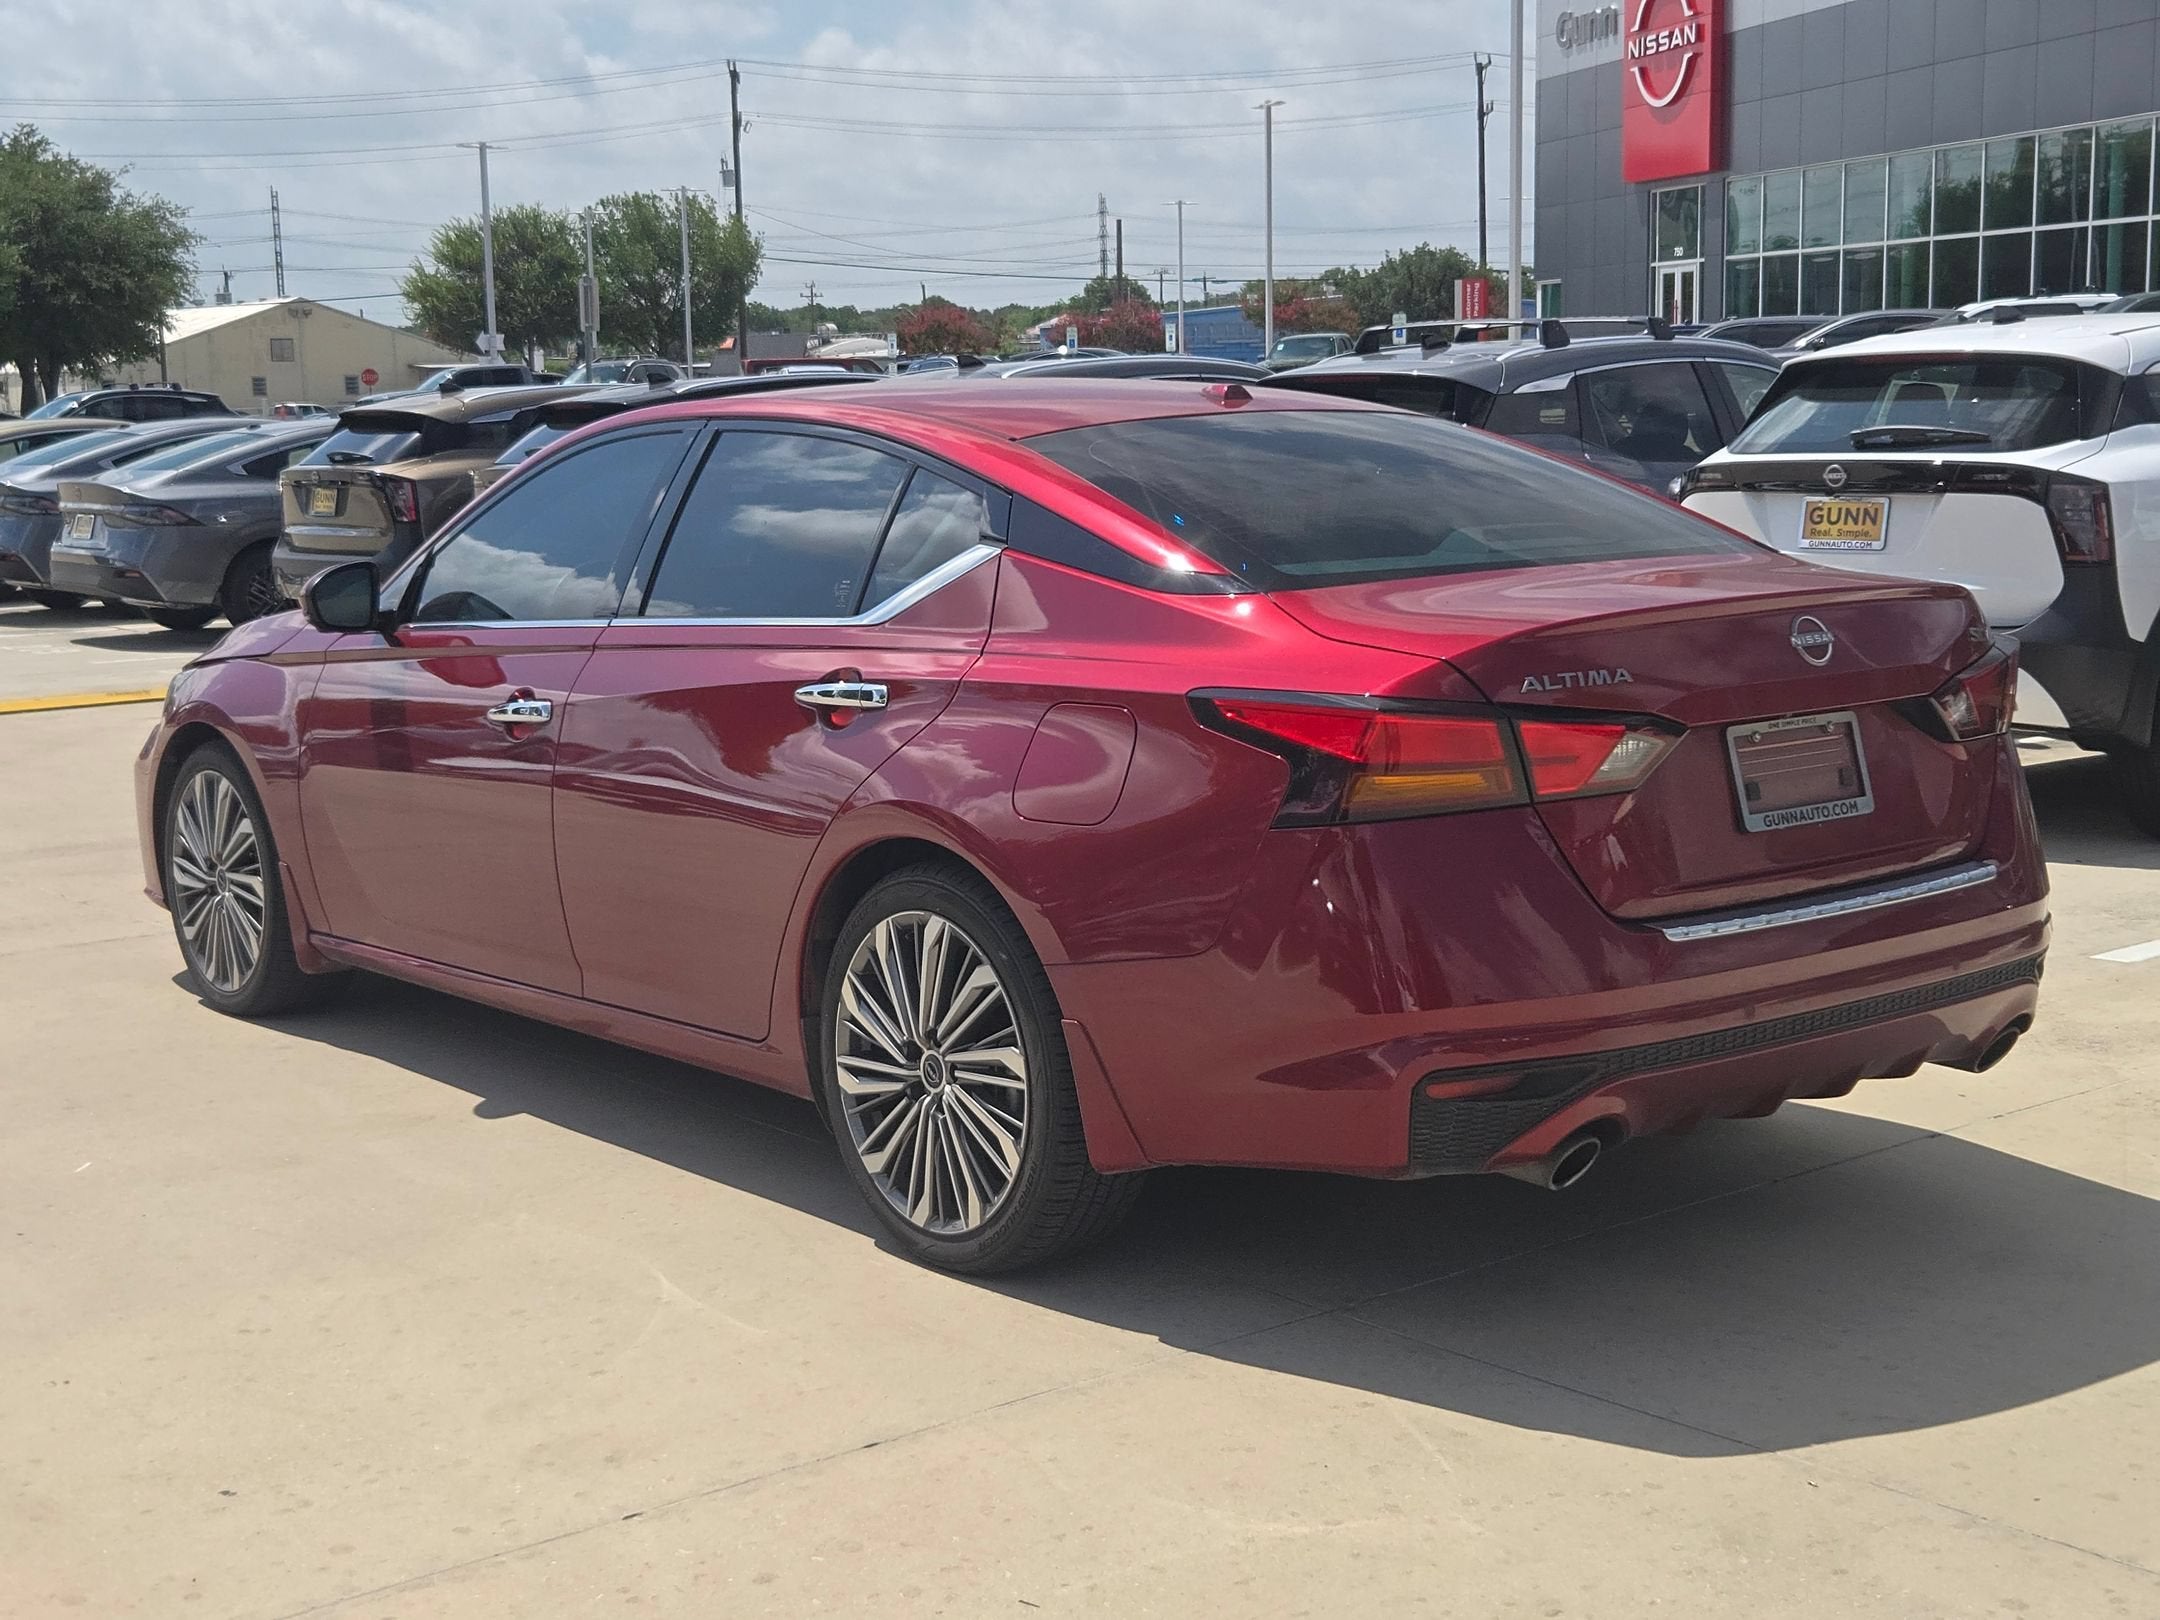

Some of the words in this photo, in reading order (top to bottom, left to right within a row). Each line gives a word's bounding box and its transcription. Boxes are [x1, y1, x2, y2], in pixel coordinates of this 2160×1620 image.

[1556, 6, 1618, 50] Gunn
[1628, 22, 1696, 60] NISSAN
[1673, 246, 1684, 257] 750
[1809, 506, 1879, 526] GUNN
[1808, 540, 1873, 549] GUNNAUTO.COM
[1810, 528, 1833, 537] Real.
[1836, 528, 1872, 539] Simple.
[1520, 667, 1634, 694] ALTIMA
[1763, 800, 1859, 828] GUNNAUTO.COM
